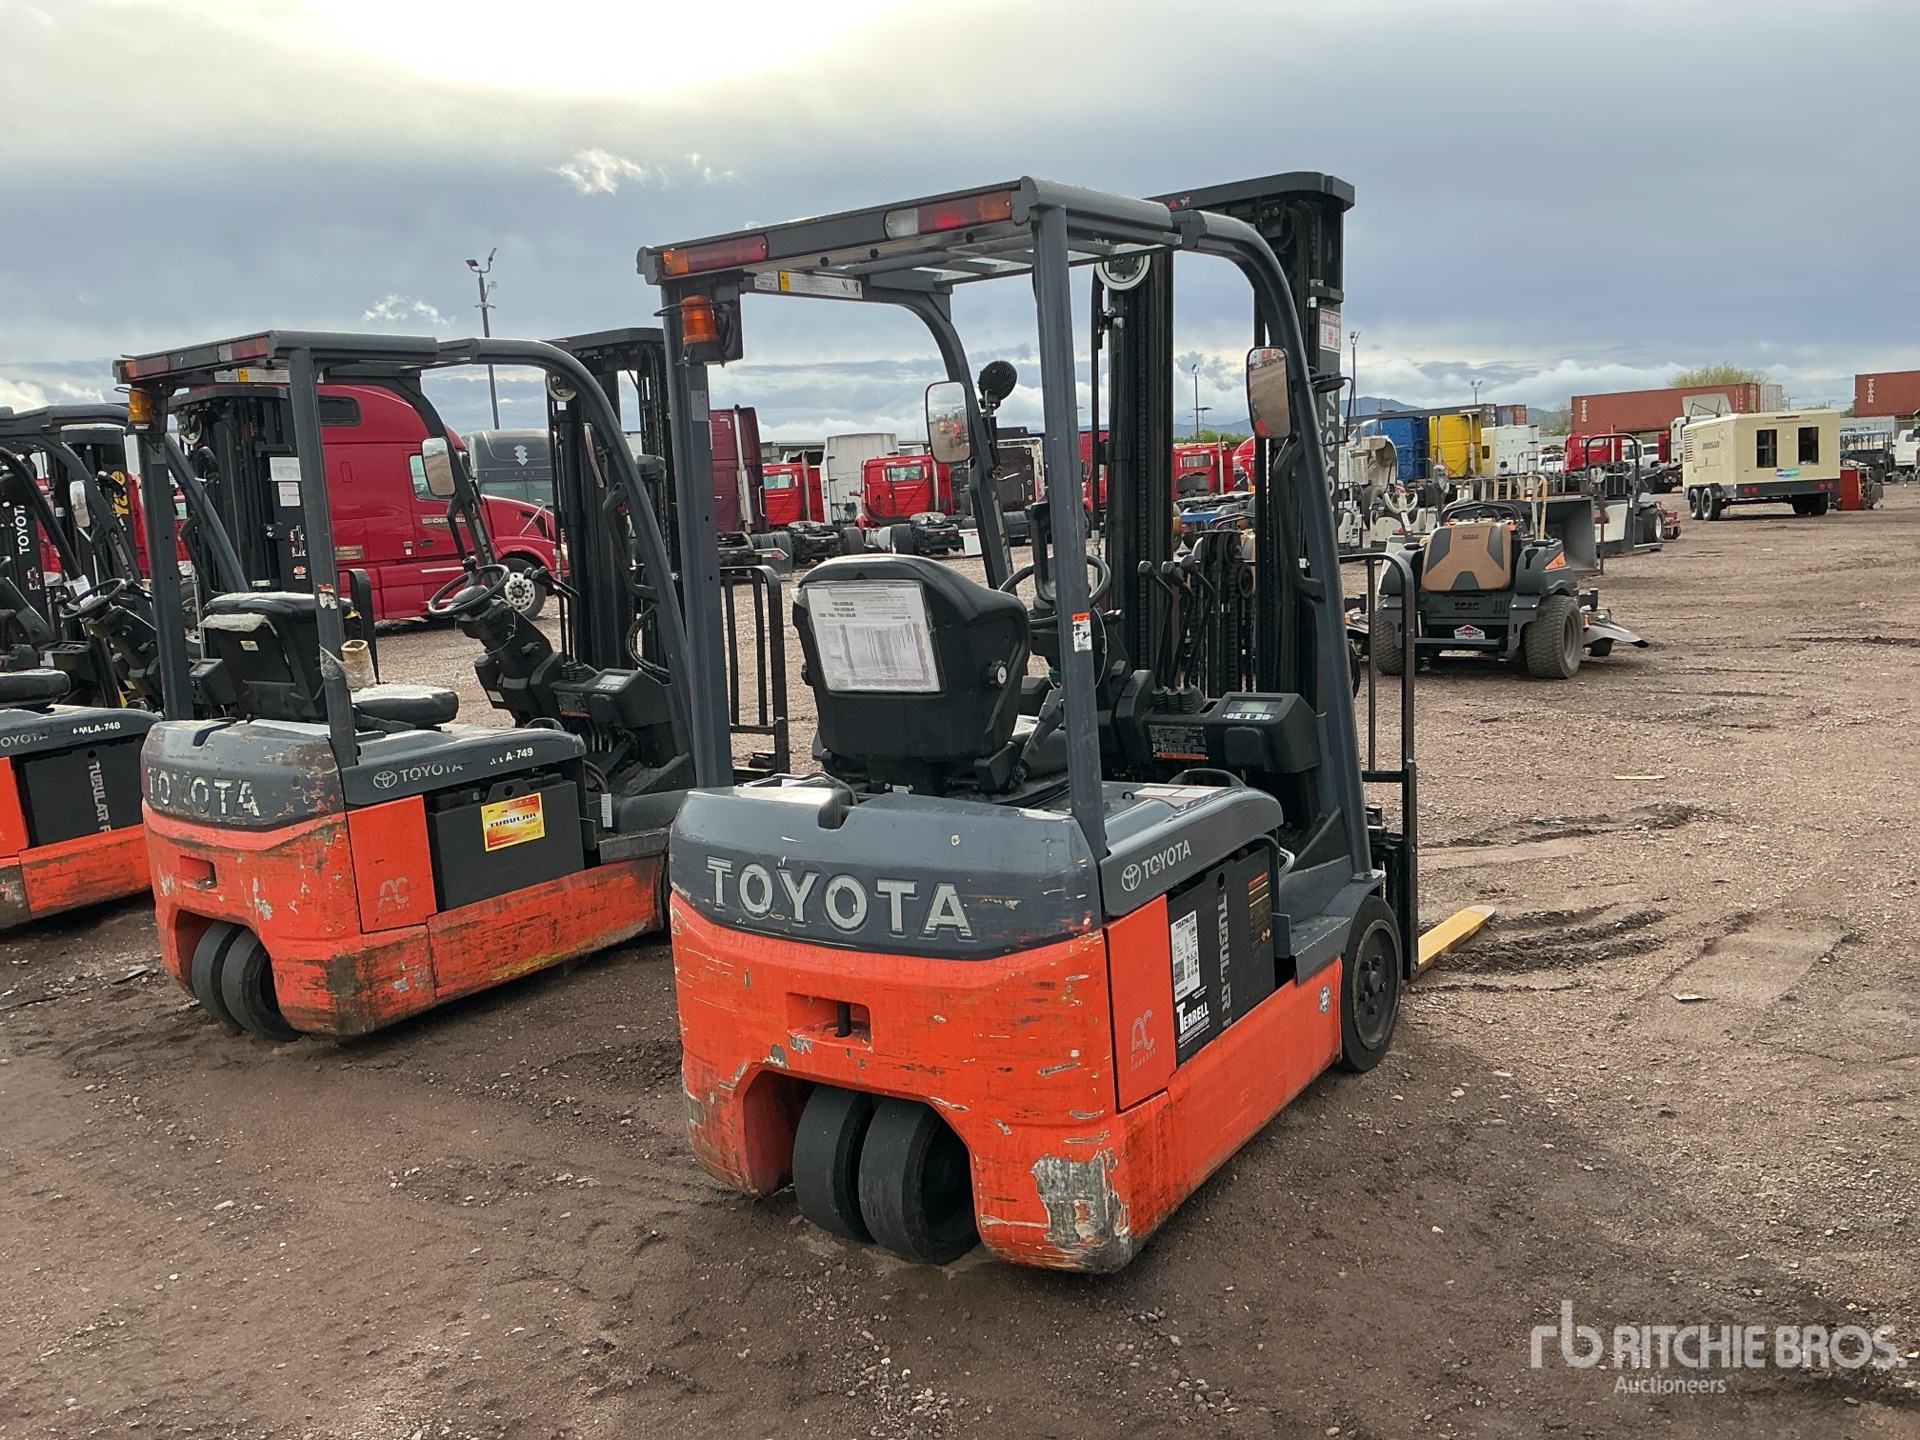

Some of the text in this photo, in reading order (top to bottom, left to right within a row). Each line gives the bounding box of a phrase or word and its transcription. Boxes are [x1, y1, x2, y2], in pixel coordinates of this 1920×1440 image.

[1325, 389, 1337, 512] OYOTA
[109, 470, 130, 516] Yae
[88, 761, 110, 822] TUBULAR
[489, 812, 537, 829] TUBULAR
[1141, 839, 1192, 880] TOYOTA
[706, 855, 974, 940] TOYOTA
[1217, 893, 1232, 1013] TUBULAR
[1176, 1001, 1210, 1035] TERRELL
